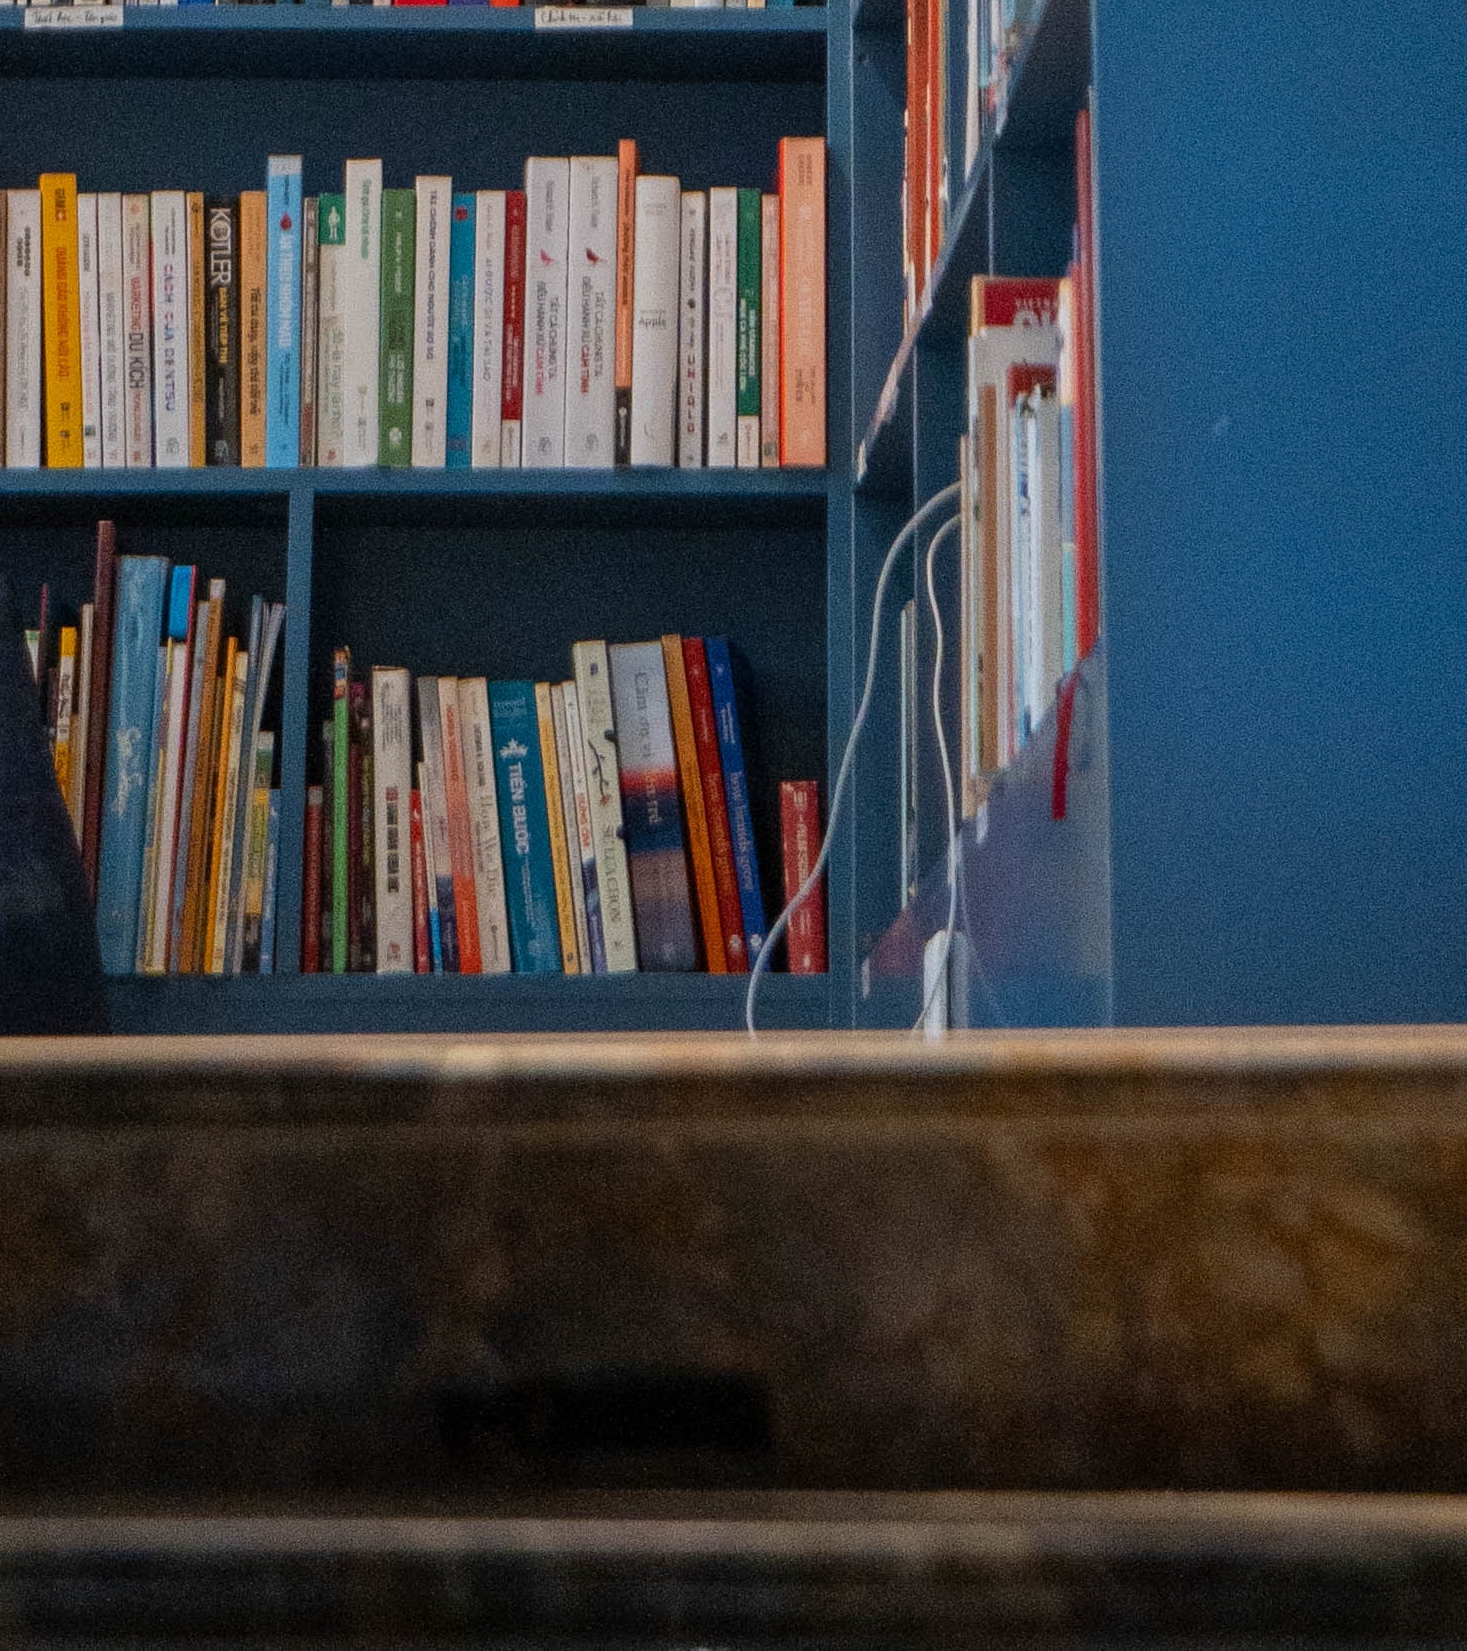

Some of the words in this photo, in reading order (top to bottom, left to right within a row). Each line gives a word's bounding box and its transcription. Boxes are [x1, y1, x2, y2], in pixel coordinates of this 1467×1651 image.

[209, 208, 232, 287] KOTLER
[131, 276, 143, 331] MARKETING
[129, 332, 144, 352] DU
[129, 357, 149, 389] KÍCH
[164, 348, 176, 412] DENTSU
[507, 762, 524, 801] TIẾN
[729, 771, 744, 802] how
[477, 794, 495, 831] How
[733, 806, 751, 853] brands
[481, 834, 498, 864] We
[486, 868, 501, 899] Die
[737, 855, 754, 892] grow
